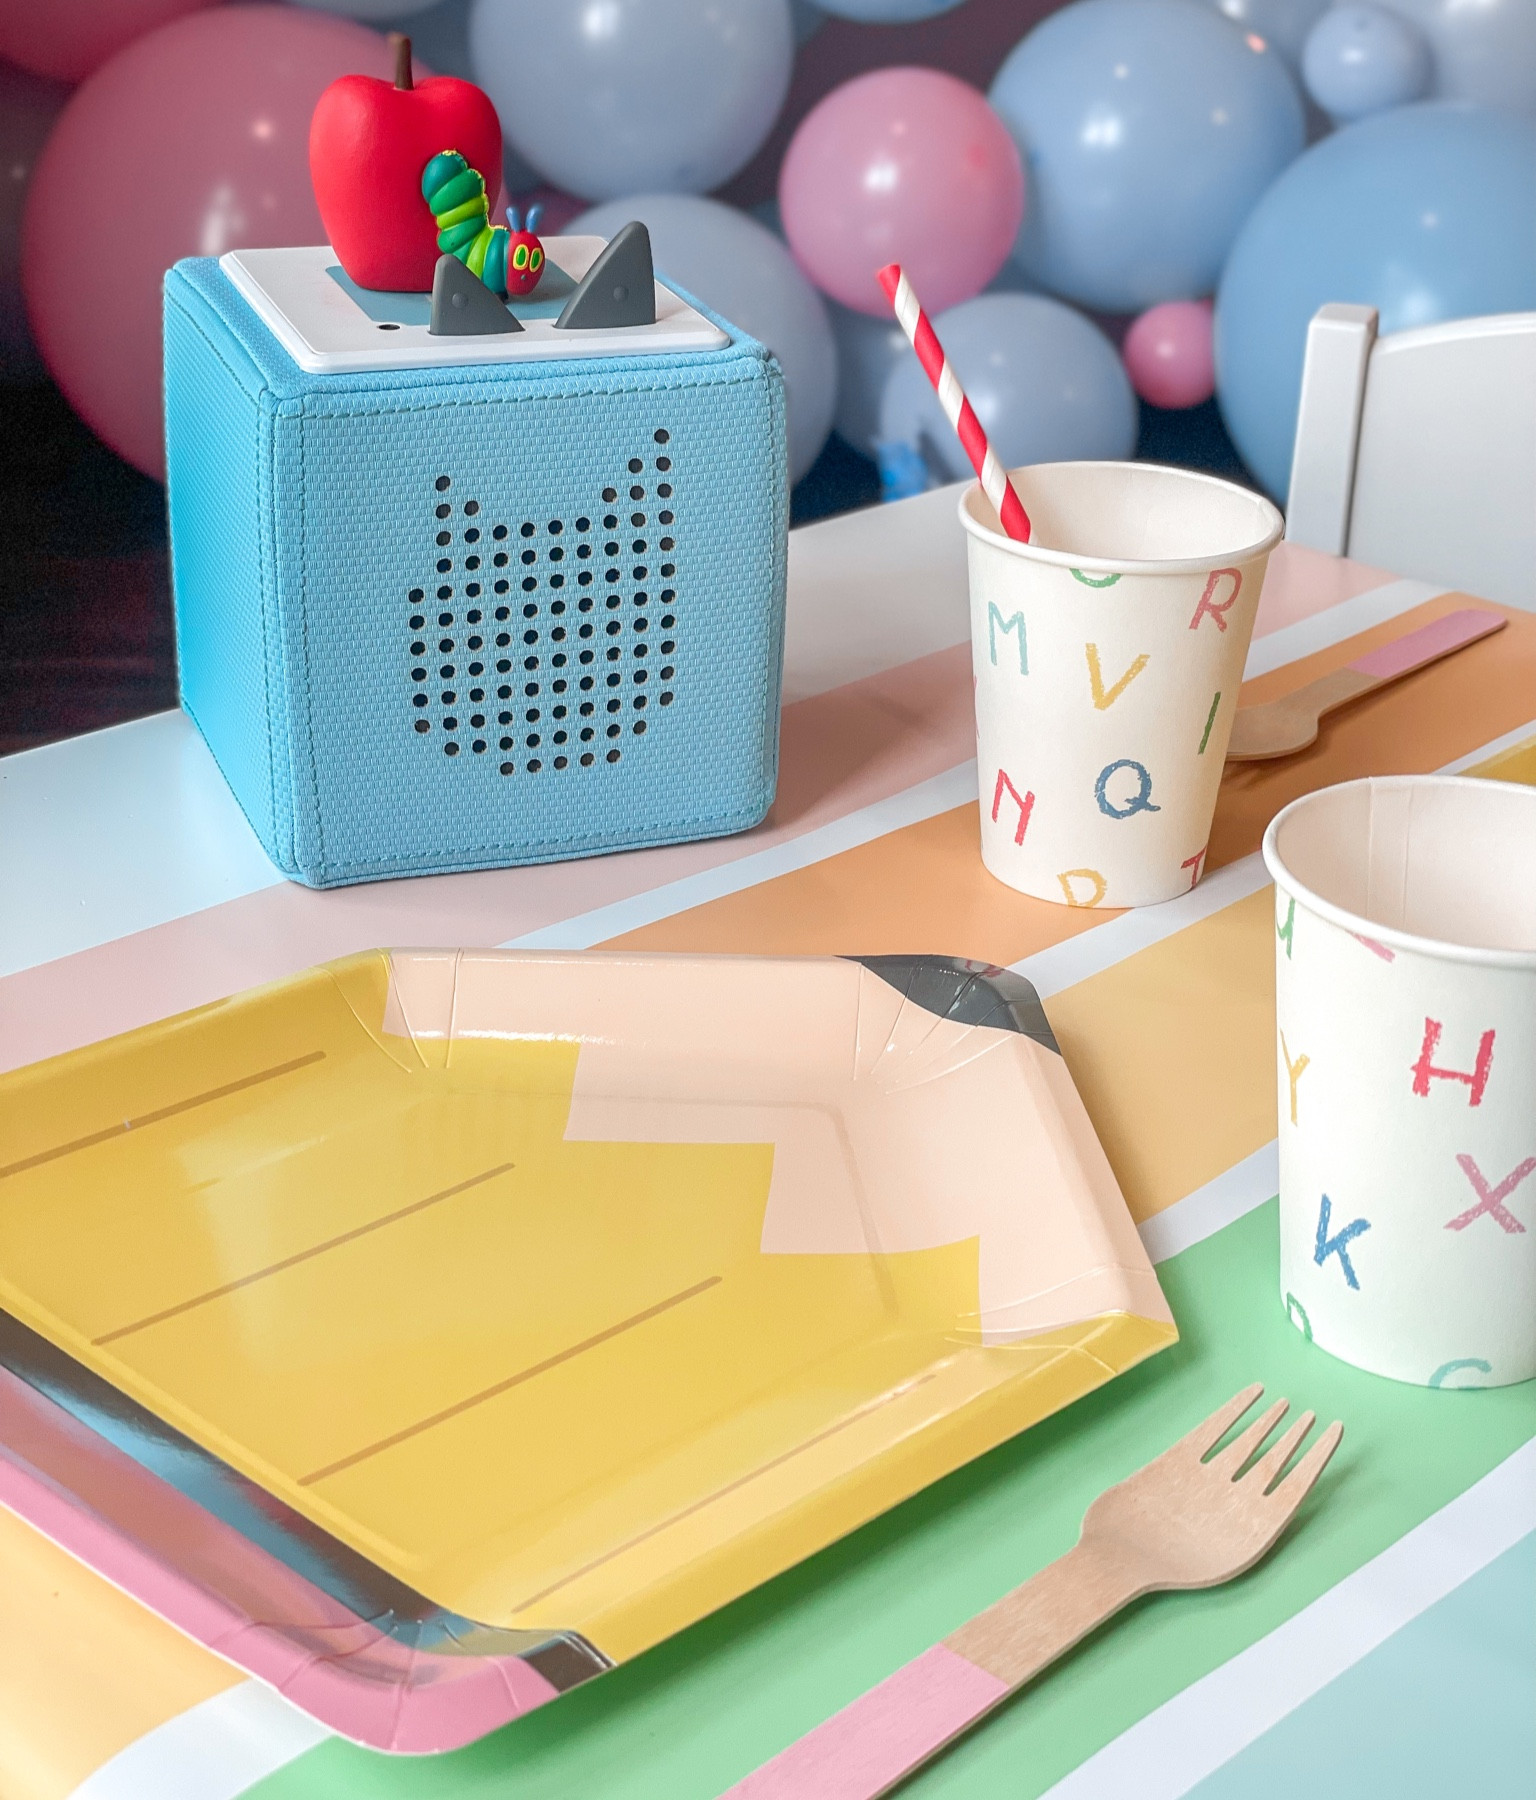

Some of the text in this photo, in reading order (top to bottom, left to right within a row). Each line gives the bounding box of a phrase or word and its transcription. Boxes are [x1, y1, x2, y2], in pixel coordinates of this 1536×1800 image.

[988, 601, 1029, 676] M
[1189, 567, 1242, 632] R
[1085, 642, 1150, 711] V
[992, 768, 1036, 846] N
[1095, 759, 1161, 819] Q
[1279, 1028, 1310, 1127] Y
[1410, 1016, 1496, 1107] H
[1444, 1153, 1536, 1234] X
[1313, 1193, 1371, 1291] K
